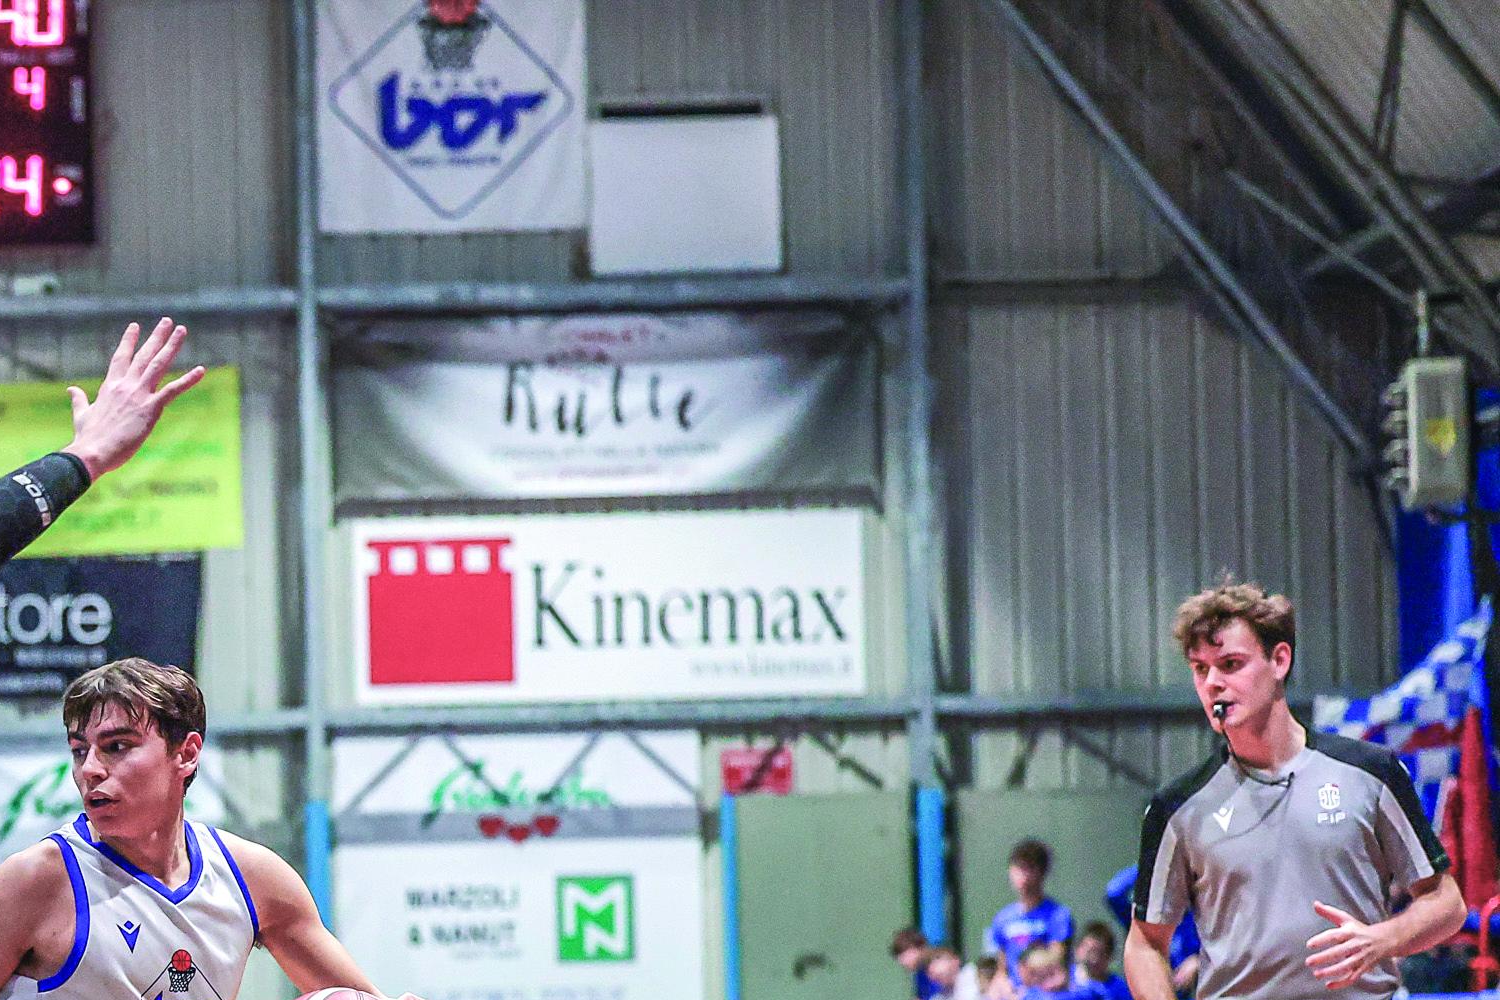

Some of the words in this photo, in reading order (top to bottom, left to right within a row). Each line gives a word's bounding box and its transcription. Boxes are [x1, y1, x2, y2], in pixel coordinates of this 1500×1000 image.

[14, 66, 46, 110] 4
[377, 70, 547, 150] bor
[531, 560, 848, 649] Kinemax
[1317, 812, 1346, 824] FIP
